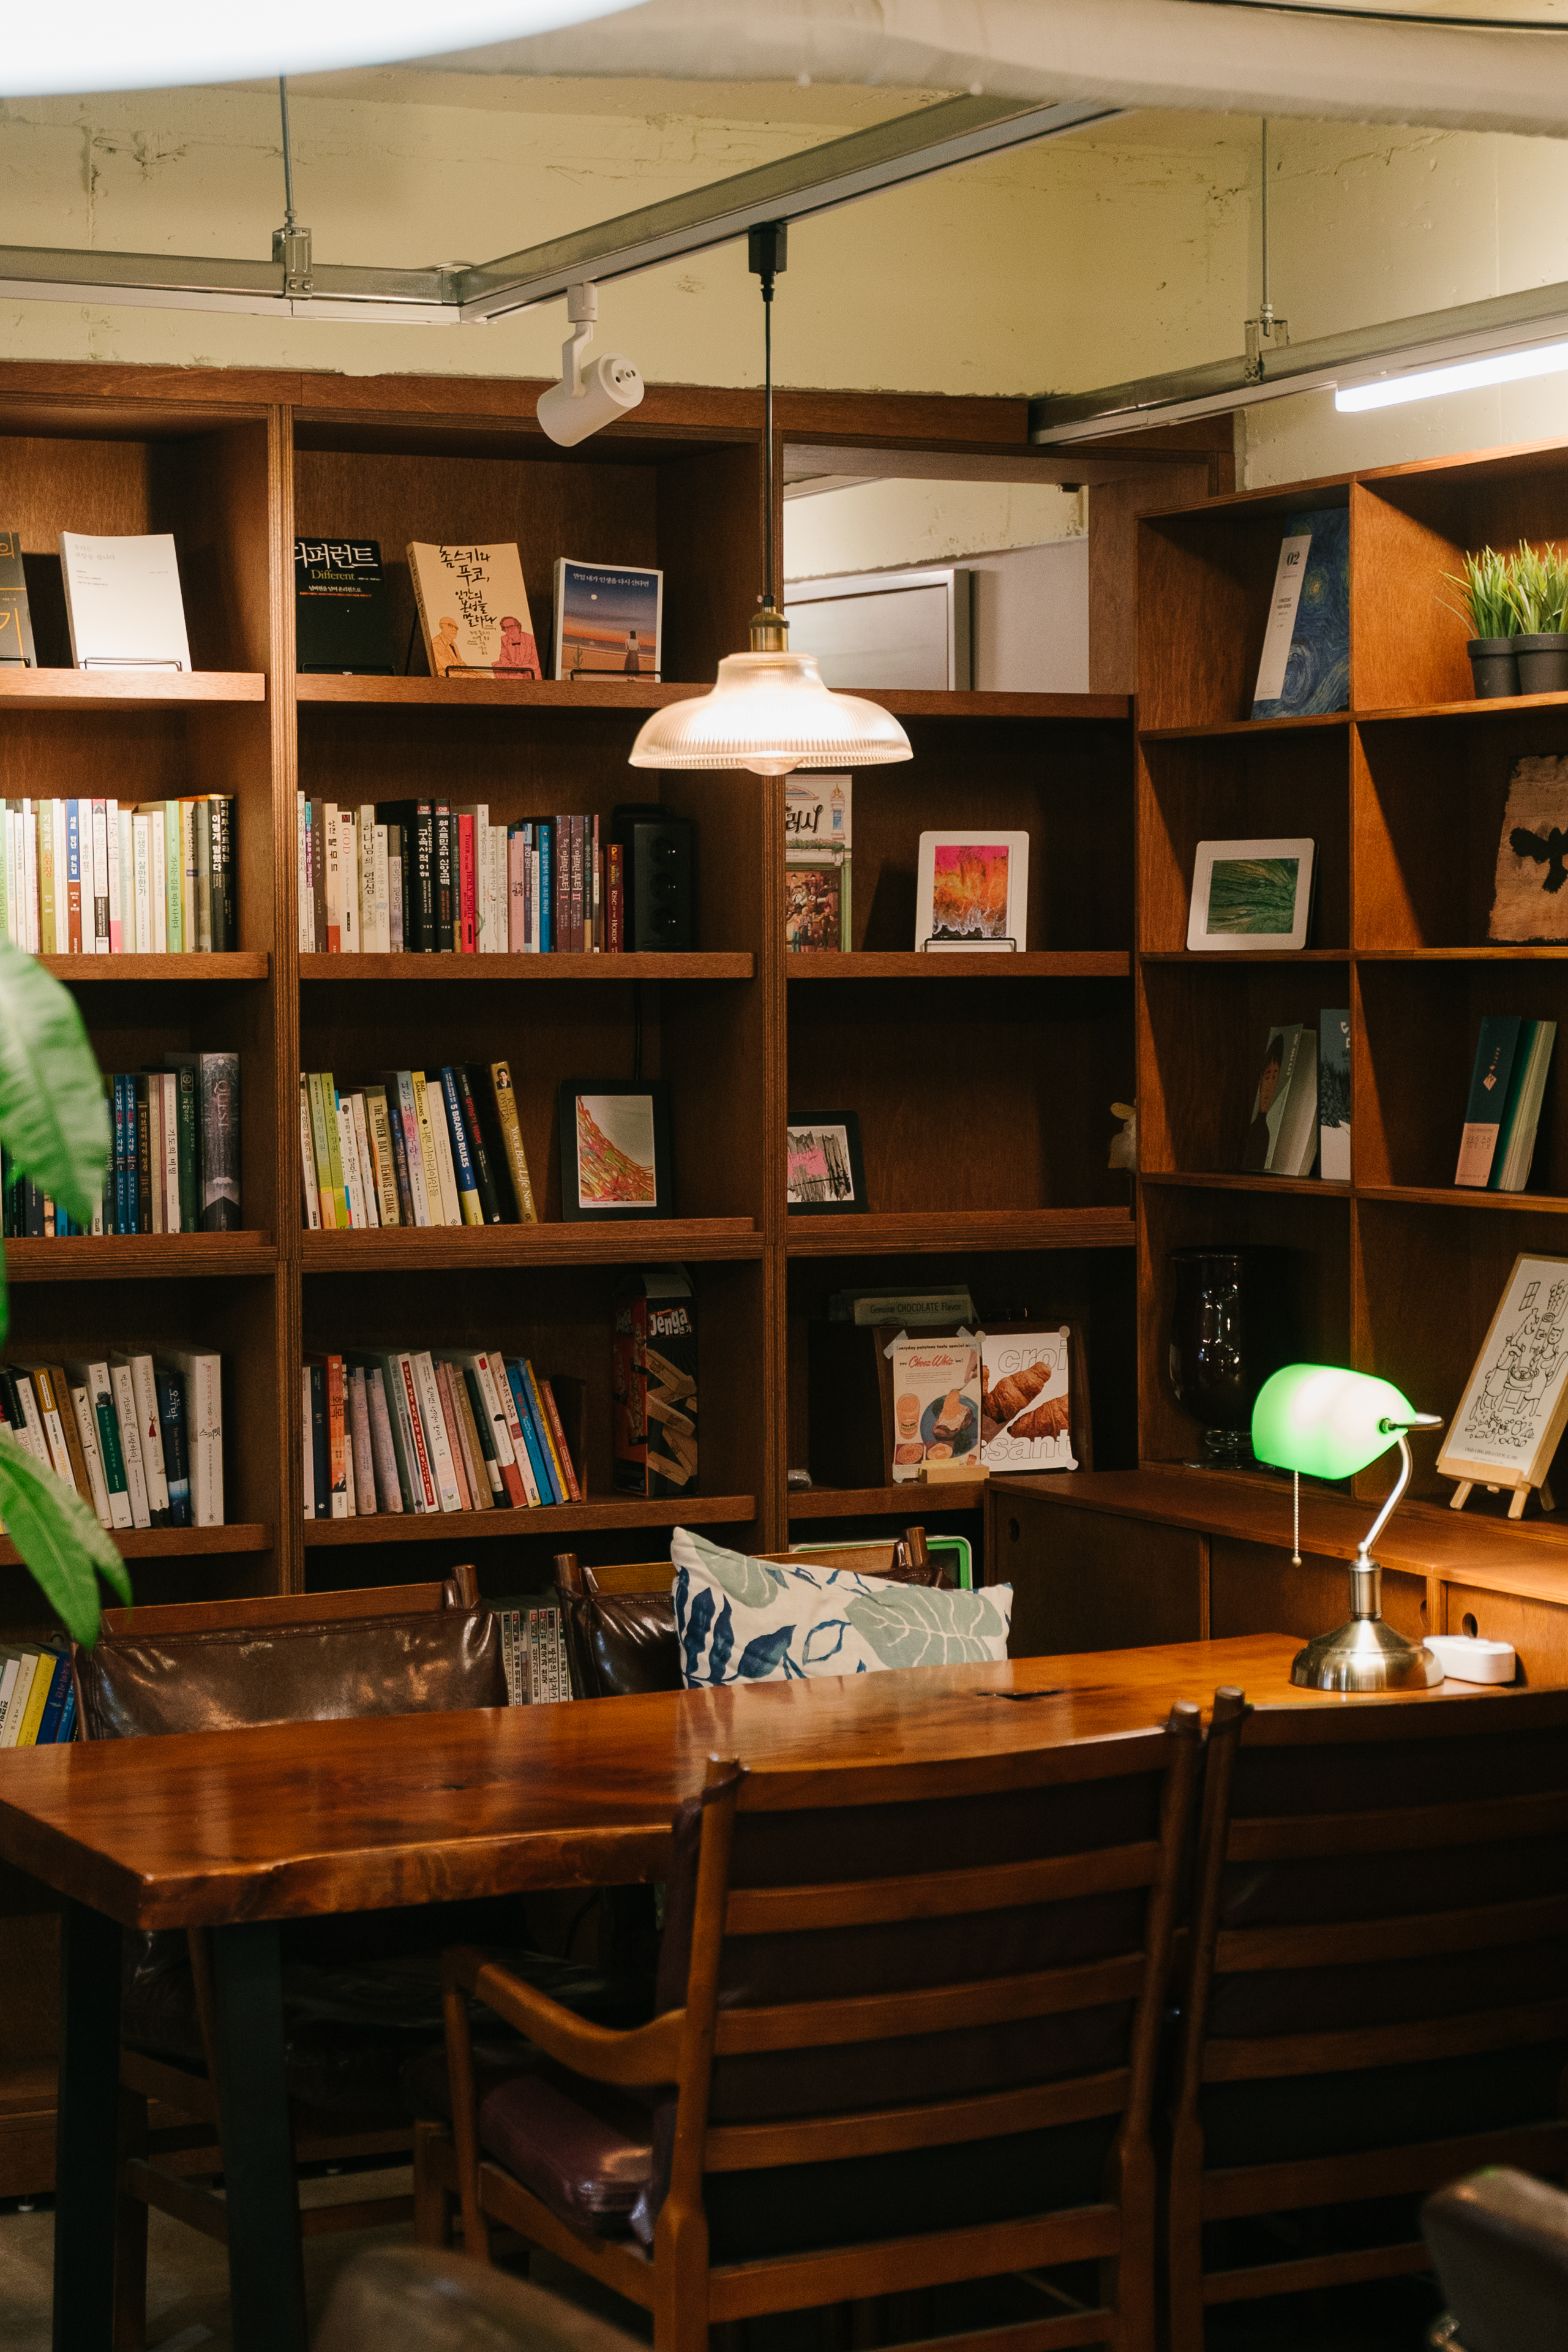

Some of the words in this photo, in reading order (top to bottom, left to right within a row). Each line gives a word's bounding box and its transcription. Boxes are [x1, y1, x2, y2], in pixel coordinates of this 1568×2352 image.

[440, 546, 490, 568] 촘스키와
[1286, 551, 1300, 566] 02
[310, 569, 355, 580] Different
[456, 565, 490, 587] 푸코,
[599, 576, 617, 585] 인생을
[455, 588, 482, 601] 인간의
[460, 599, 487, 614] 본성을
[463, 614, 498, 628] 말하다
[42, 813, 53, 851] 기독교의
[95, 817, 104, 835] 예수
[212, 814, 221, 841] 이렇게
[328, 819, 336, 835] 성전
[95, 837, 105, 853] 없는
[137, 830, 146, 857] 인생은
[342, 827, 351, 855] GOD
[363, 822, 374, 865] 하나님의
[438, 819, 449, 856] 웨스트민스터
[43, 853, 54, 878] 심장
[96, 856, 105, 874] 예수
[212, 845, 222, 872] 말했다
[138, 861, 147, 896] 살만한가
[364, 871, 375, 895] 열심
[440, 859, 450, 885] 신앙고백
[559, 871, 570, 891] 루터
[572, 871, 582, 891] 루터
[96, 876, 106, 893] 교회
[170, 877, 179, 891] 길을
[171, 893, 179, 907] 따라
[171, 908, 180, 930] 나서다
[214, 1079, 230, 1128] QUEST
[415, 1080, 424, 1117] SAMARITANS
[498, 1092, 511, 1124] OSTEEN
[508, 1096, 516, 1116] JOEL
[356, 1108, 366, 1130] 이중섭
[373, 1104, 382, 1116] THE
[375, 1118, 385, 1138] GIVEN
[422, 1126, 432, 1144] 나쁜
[451, 1110, 464, 1142] BRAND
[511, 1125, 520, 1148] YOUR
[168, 1129, 176, 1154] 기도의
[378, 1141, 388, 1154] DAY
[168, 1157, 177, 1174] 비밀
[457, 1142, 470, 1168] RULES
[515, 1149, 525, 1168] Best
[381, 1164, 392, 1189] DENNIS
[424, 1144, 438, 1198] 사마리아인들
[519, 1169, 529, 1188] Life
[384, 1190, 395, 1215] LEHANE
[870, 1305, 895, 1313] Genuine
[897, 1302, 939, 1313] CHOCOLATE
[941, 1302, 962, 1311] Flavor
[650, 1309, 688, 1336] Jenga
[998, 1339, 1067, 1373] croi
[165, 1389, 180, 1419] 오두막
[331, 1395, 342, 1419] 회복
[552, 1416, 563, 1437] Morrie
[129, 1432, 137, 1458] 사랑하라
[981, 1429, 1072, 1461] sant
[548, 1648, 557, 1672] 땅끝의
[549, 1676, 558, 1699] 십자가
